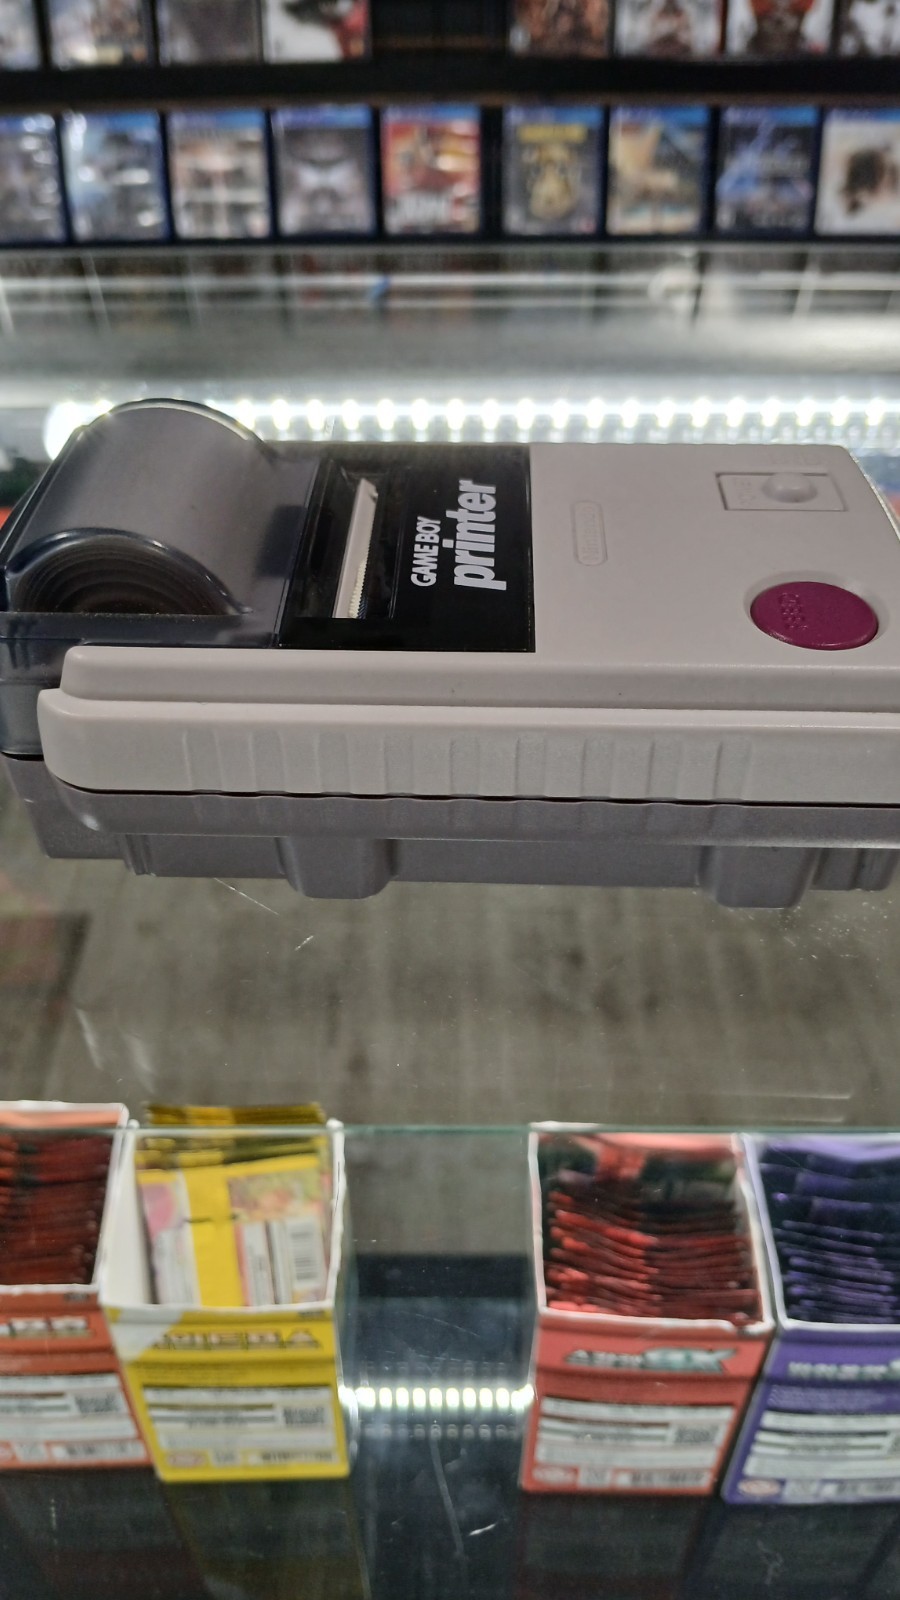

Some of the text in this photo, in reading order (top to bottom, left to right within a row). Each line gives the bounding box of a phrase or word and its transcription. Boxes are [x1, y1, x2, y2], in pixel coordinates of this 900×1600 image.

[410, 516, 441, 587] GAME BOY
[442, 479, 508, 591] printer
